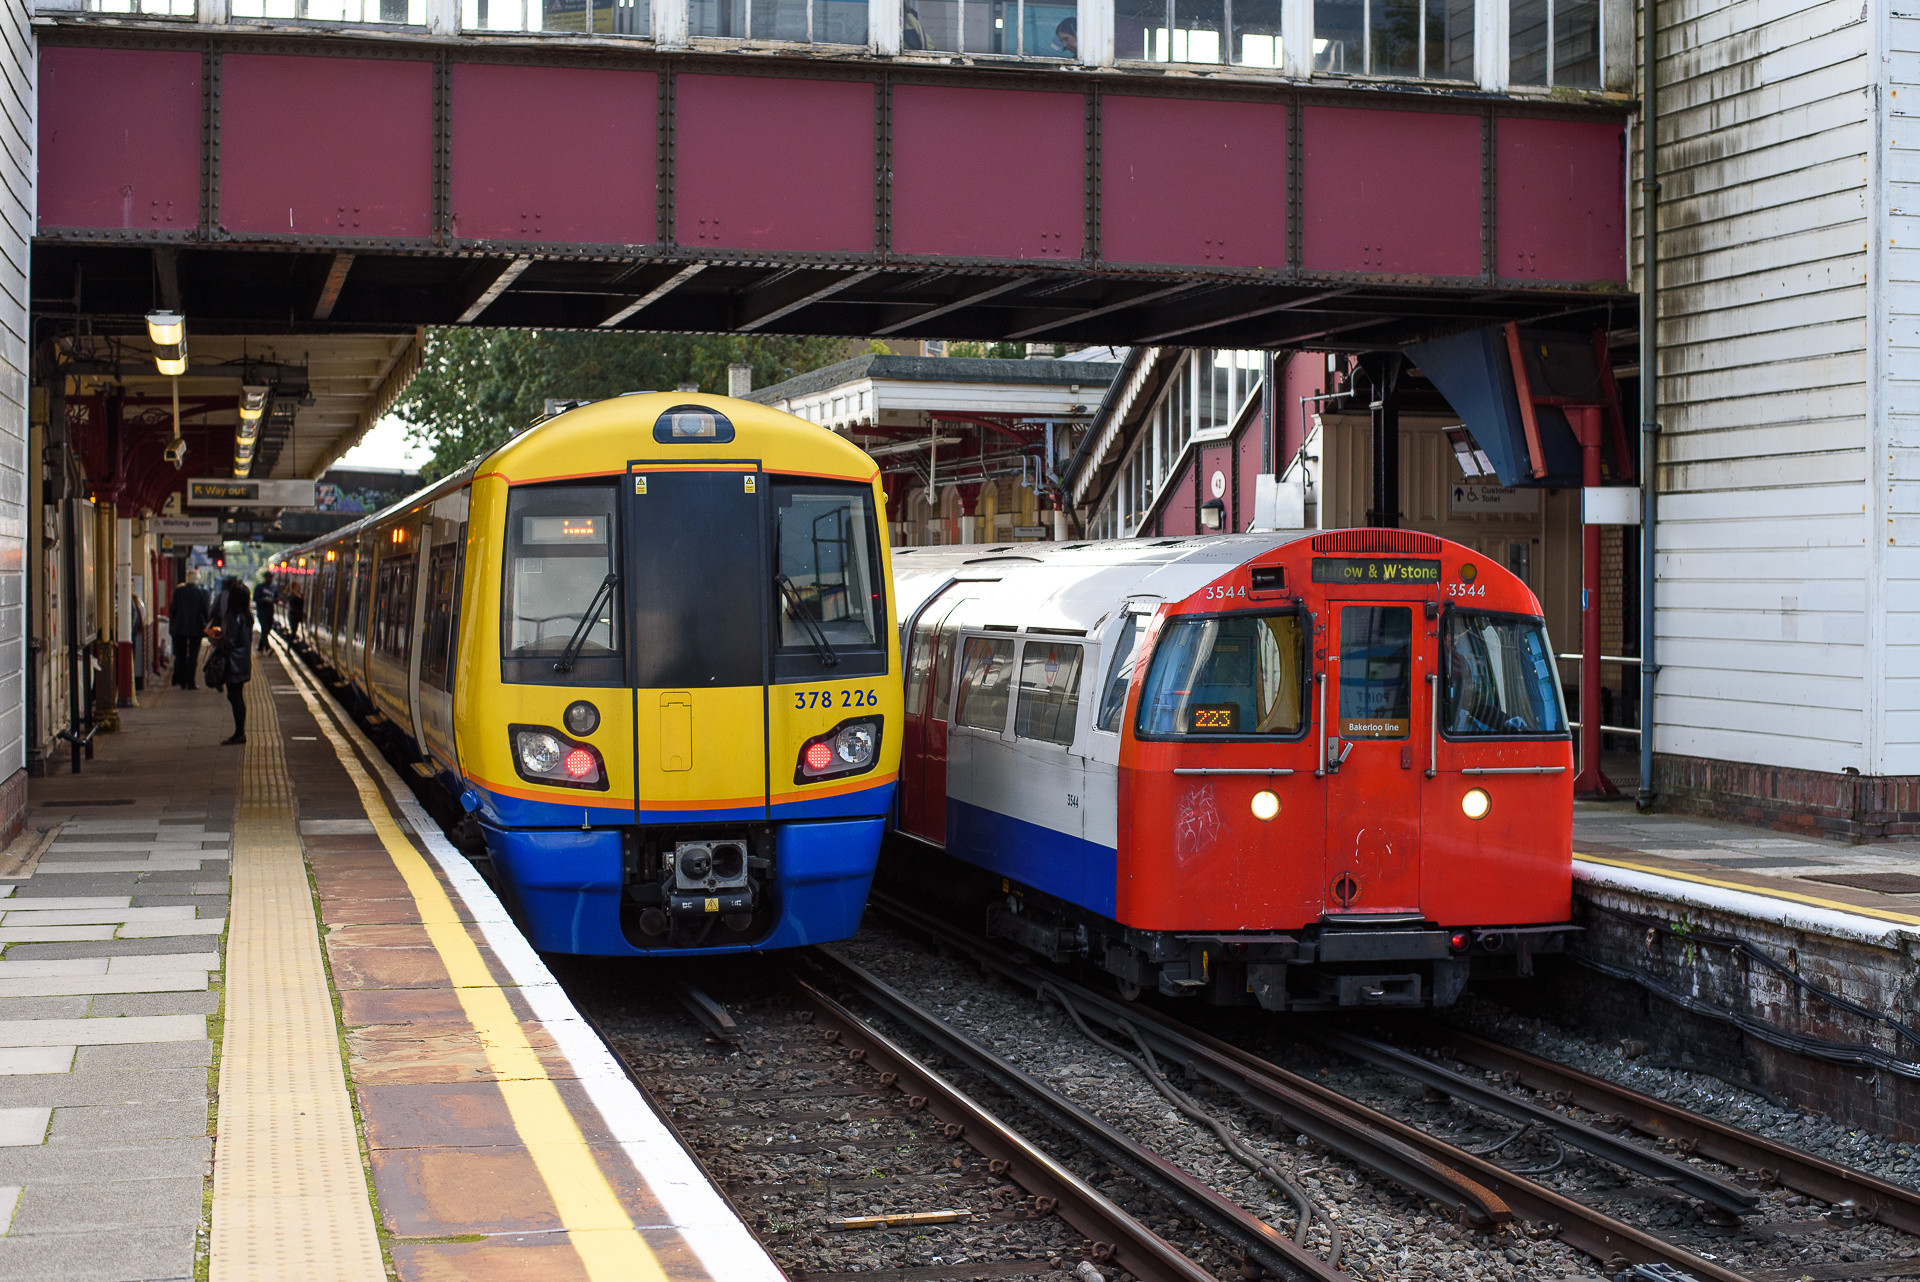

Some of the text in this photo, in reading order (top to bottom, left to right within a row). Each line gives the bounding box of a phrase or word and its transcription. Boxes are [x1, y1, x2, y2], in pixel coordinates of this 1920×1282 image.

[205, 485, 246, 497] Way out
[1481, 486, 1516, 494] Customer
[165, 495, 174, 508] 2
[162, 520, 190, 529] Waiting
[1315, 564, 1438, 579] Hrow & W'stone
[1205, 585, 1246, 600] 3544
[1448, 583, 1486, 597] 3544
[794, 689, 878, 709] 378 226
[1195, 710, 1231, 727] 223
[1348, 723, 1400, 731] Bakerloo line
[1067, 793, 1079, 808] 3544
